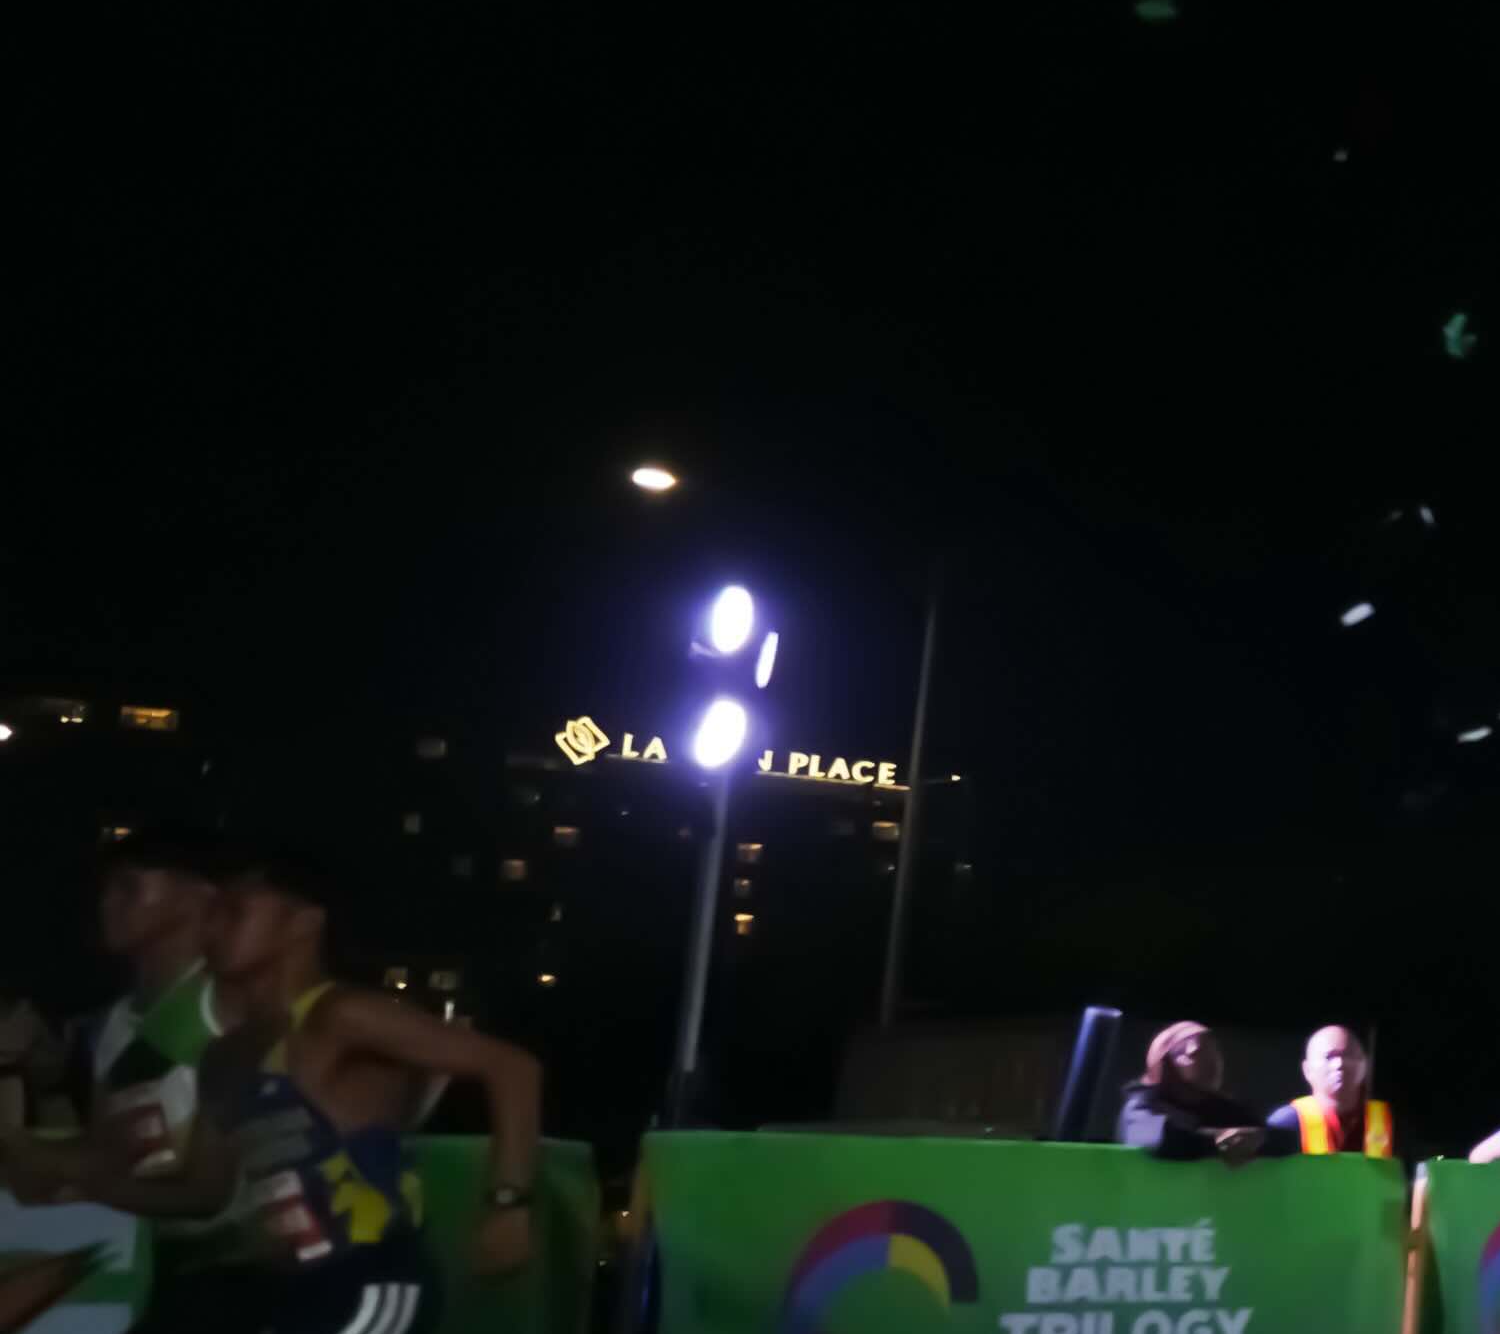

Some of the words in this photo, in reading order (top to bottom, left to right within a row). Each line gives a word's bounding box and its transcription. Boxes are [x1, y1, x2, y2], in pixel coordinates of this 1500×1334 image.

[788, 751, 898, 786] PLACE
[1050, 1218, 1219, 1265] SANTÉ
[1025, 1265, 1231, 1305] BARLEY
